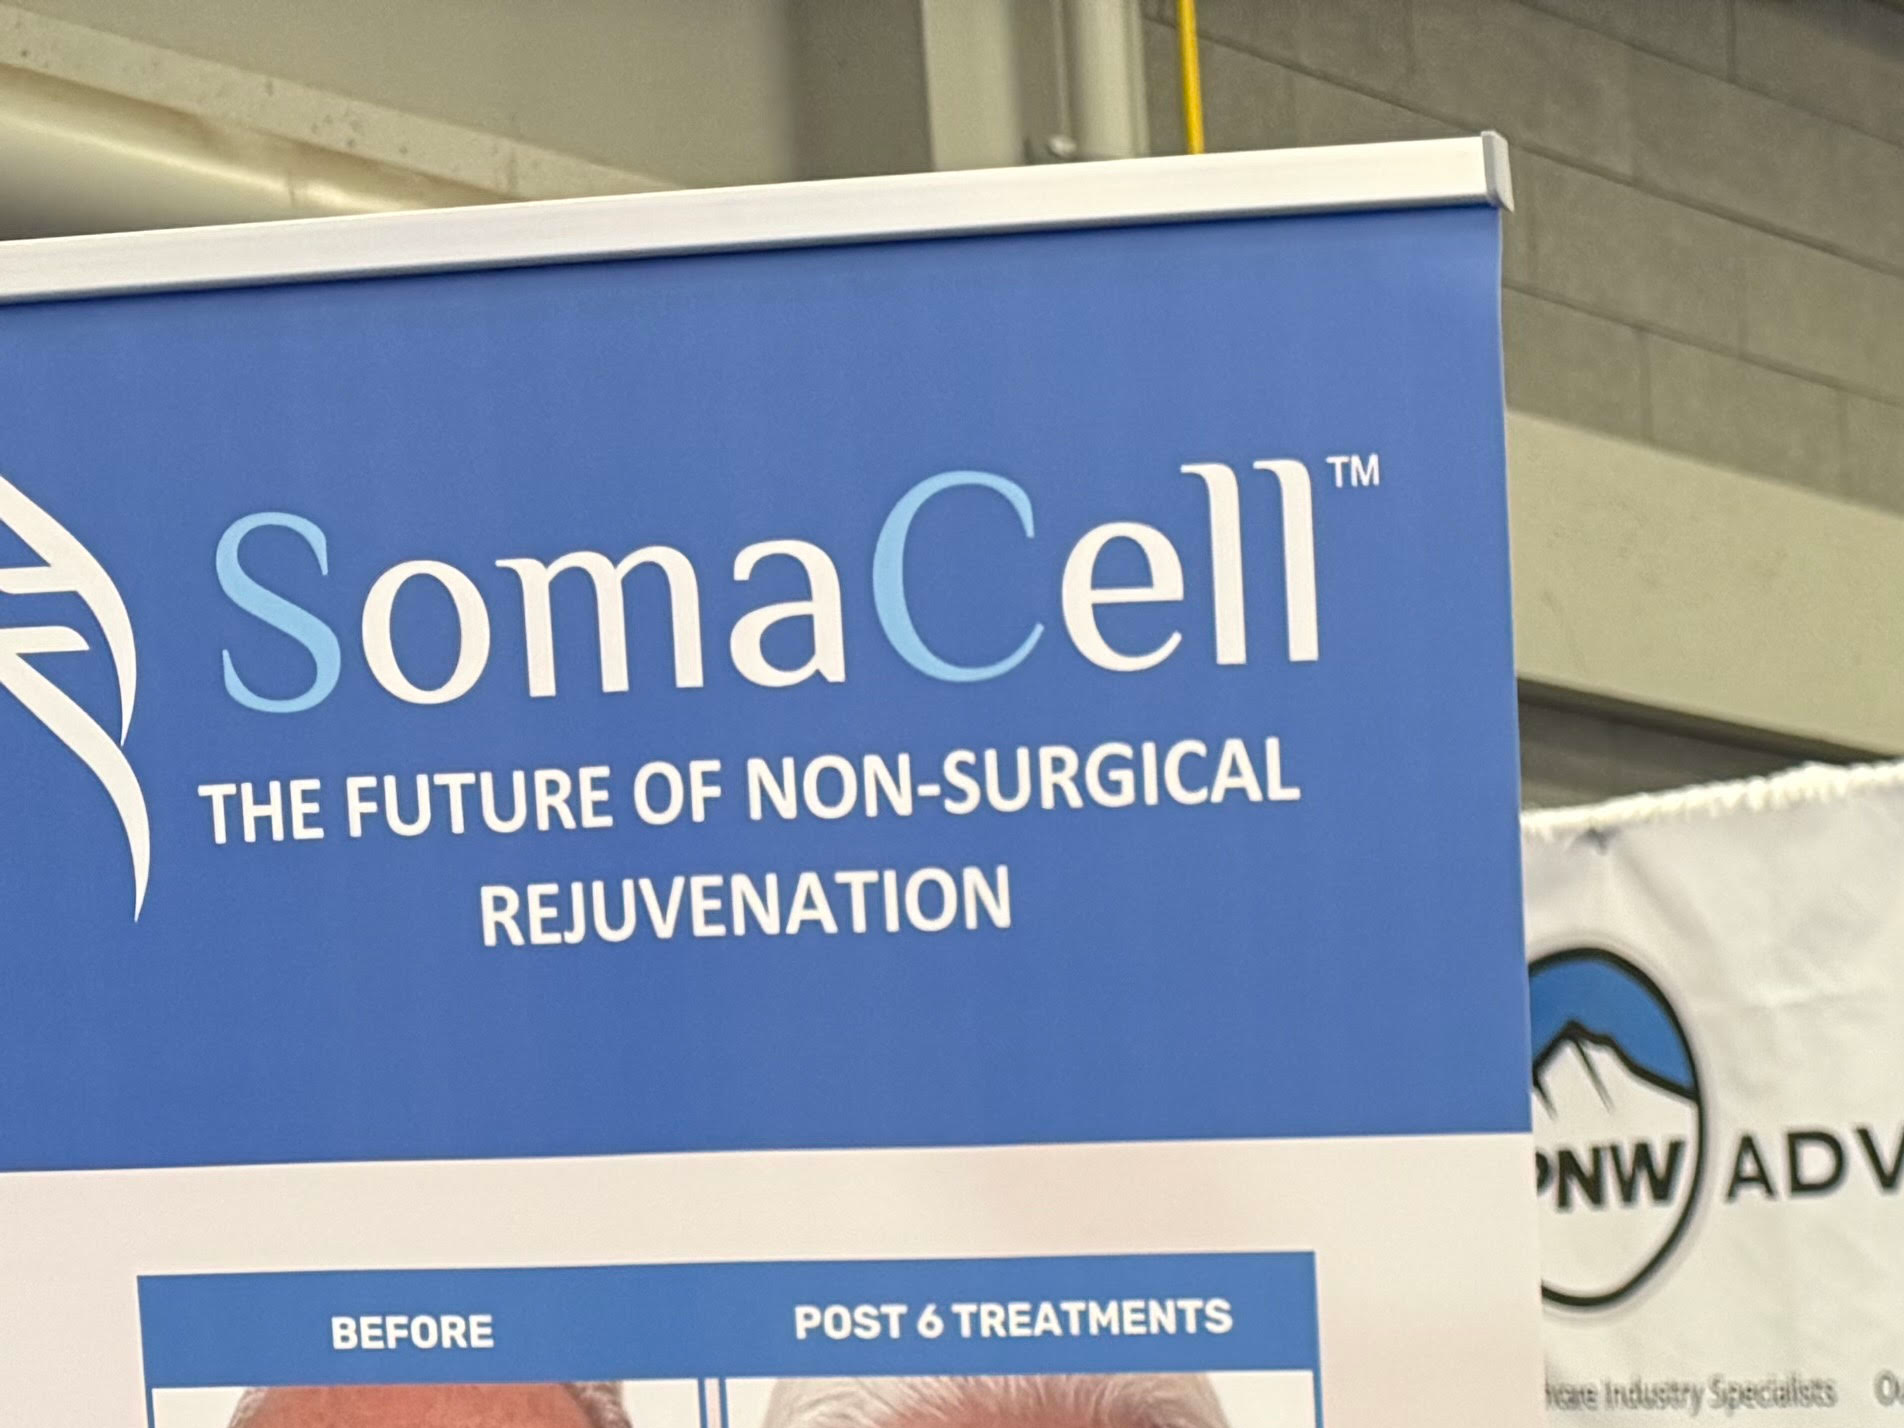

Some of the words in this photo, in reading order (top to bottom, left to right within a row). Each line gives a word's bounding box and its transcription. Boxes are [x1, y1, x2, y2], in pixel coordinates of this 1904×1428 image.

[198, 780, 324, 845] THE
[346, 762, 613, 840] FUTURE
[633, 756, 725, 826] OF
[748, 735, 1301, 822] NON-SURGICAL
[480, 863, 1012, 947] REJUVENATION
[330, 1312, 496, 1352] BEFORE
[794, 1302, 910, 1343] POST
[917, 1302, 944, 1339] 6
[951, 1296, 1234, 1339] TREATMENTS
[1604, 1372, 1703, 1417] Industry
[1709, 1372, 1838, 1413] Specialists
